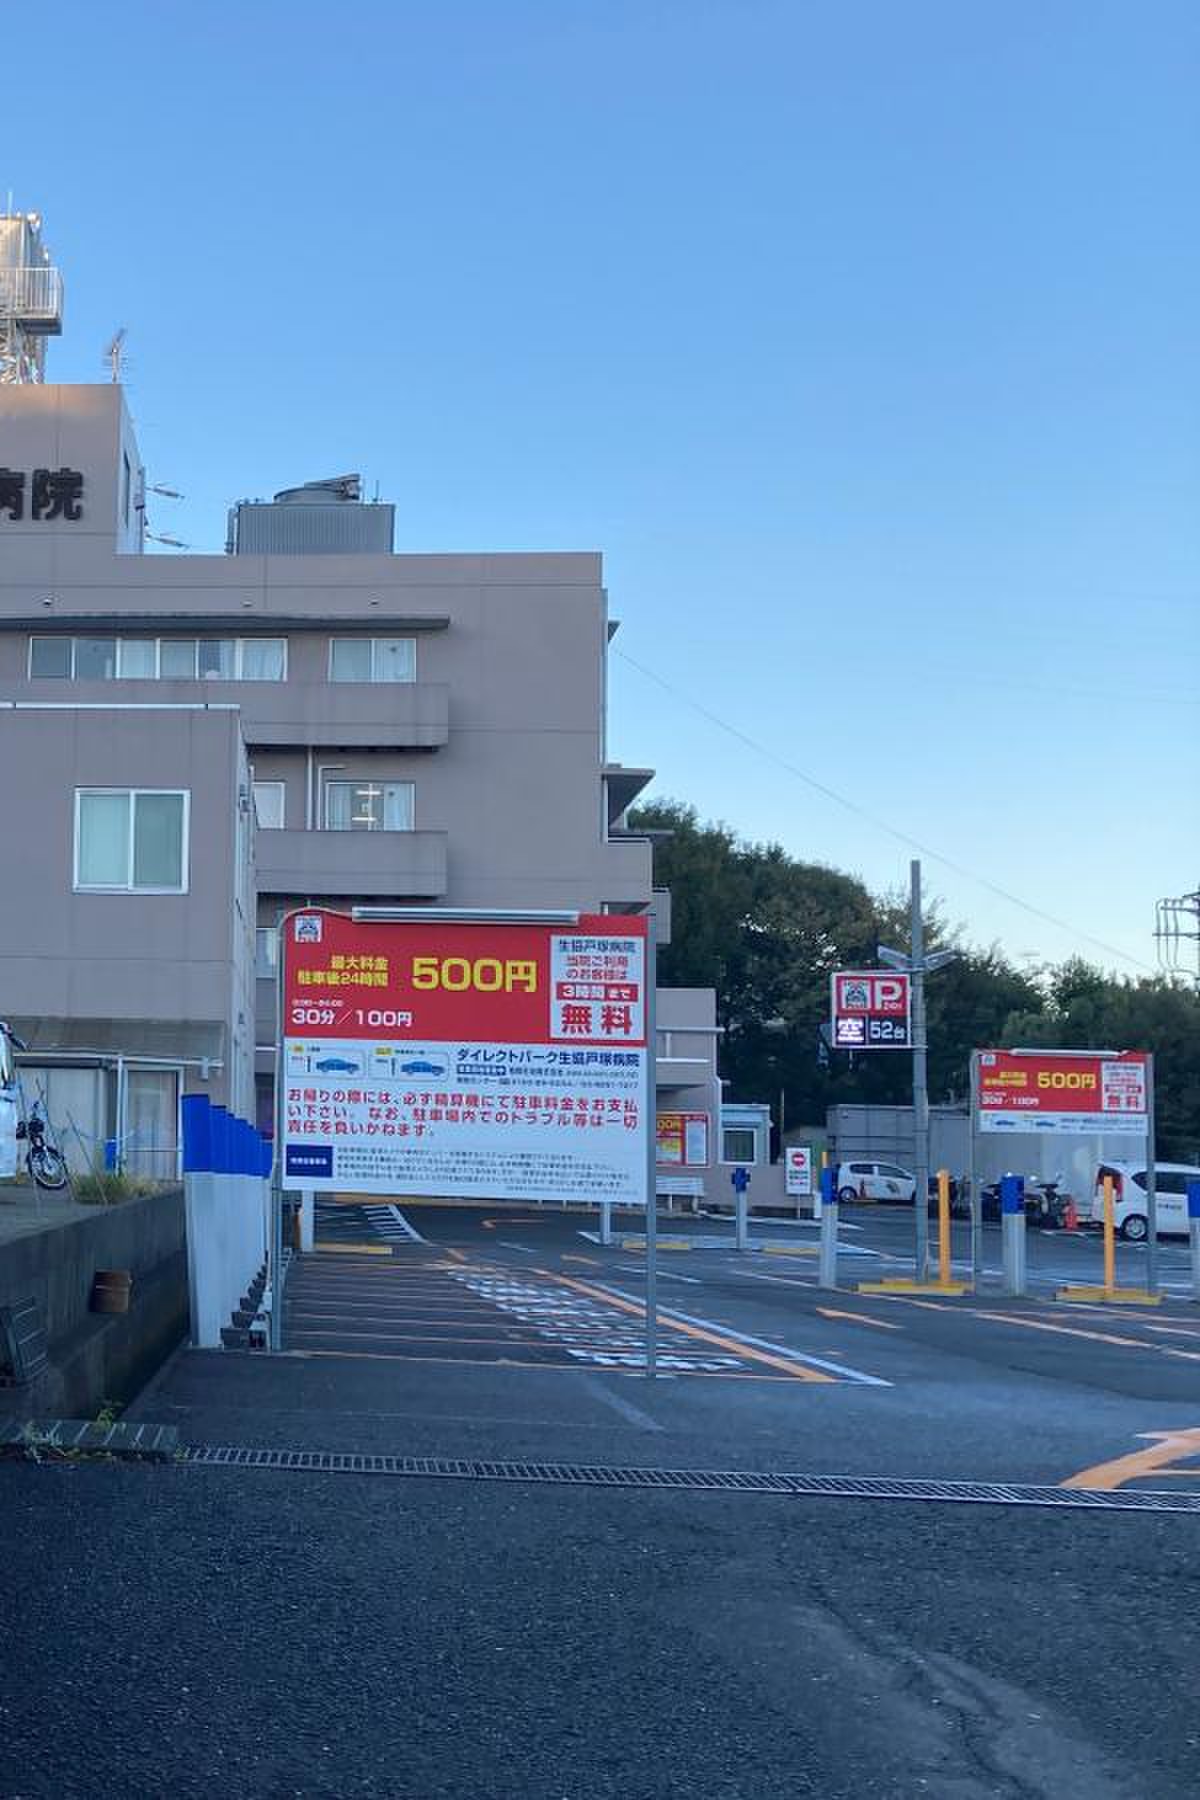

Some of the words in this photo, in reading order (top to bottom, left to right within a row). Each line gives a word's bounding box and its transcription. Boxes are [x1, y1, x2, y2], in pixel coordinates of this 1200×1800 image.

[331, 955, 389, 971] 最大料金
[412, 957, 537, 993] 500円
[874, 980, 903, 1011] P
[561, 1004, 633, 1035] 無料
[838, 1018, 864, 1042] 空
[870, 1021, 905, 1040] 52台
[457, 1048, 641, 1067] ダイレクトパーク生協戸塚病院
[1037, 1071, 1097, 1089] 500円
